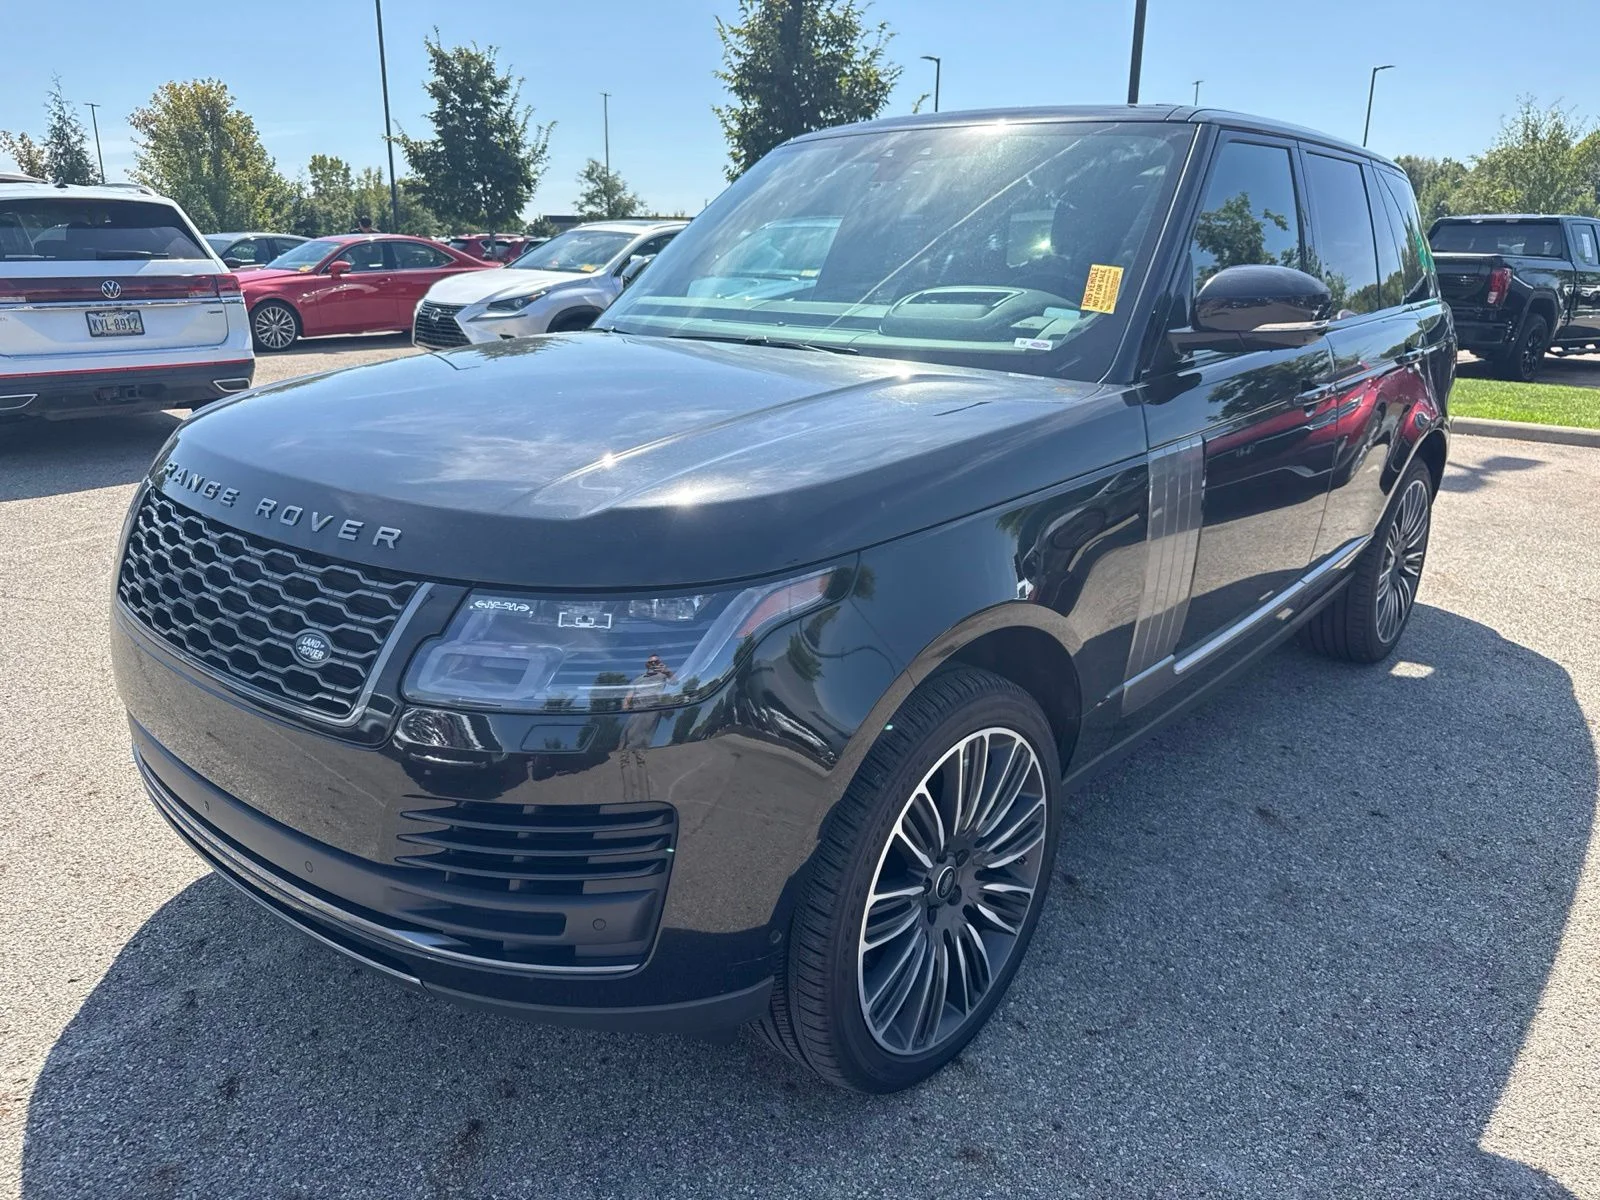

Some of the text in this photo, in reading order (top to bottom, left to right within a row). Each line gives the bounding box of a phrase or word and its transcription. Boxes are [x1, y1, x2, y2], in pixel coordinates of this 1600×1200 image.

[1098, 269, 1107, 284] SALE
[1083, 267, 1099, 307] THIS VEHICLE
[1095, 284, 1104, 296] FOR
[1092, 296, 1101, 307] NOT
[164, 462, 402, 549] RANGE ROVER
[300, 637, 324, 660] LAND ROVER
